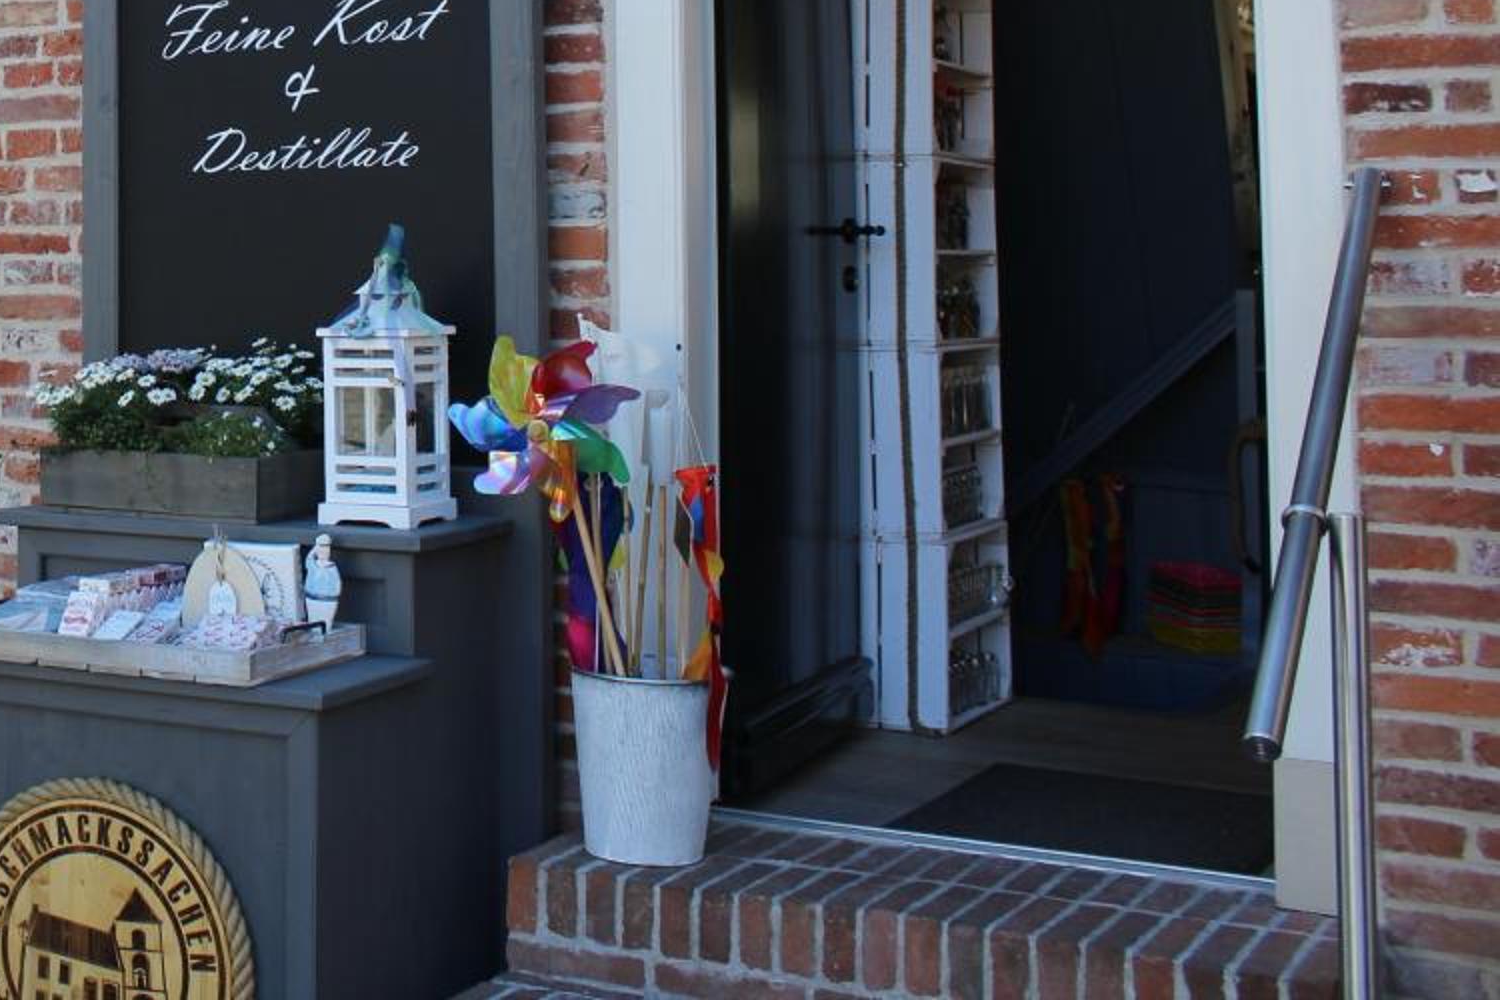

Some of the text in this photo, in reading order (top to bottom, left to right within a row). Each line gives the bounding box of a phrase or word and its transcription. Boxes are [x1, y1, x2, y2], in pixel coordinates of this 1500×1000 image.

[162, 0, 295, 60] Feine
[284, 63, 320, 112] &
[193, 127, 420, 173] Destillate
